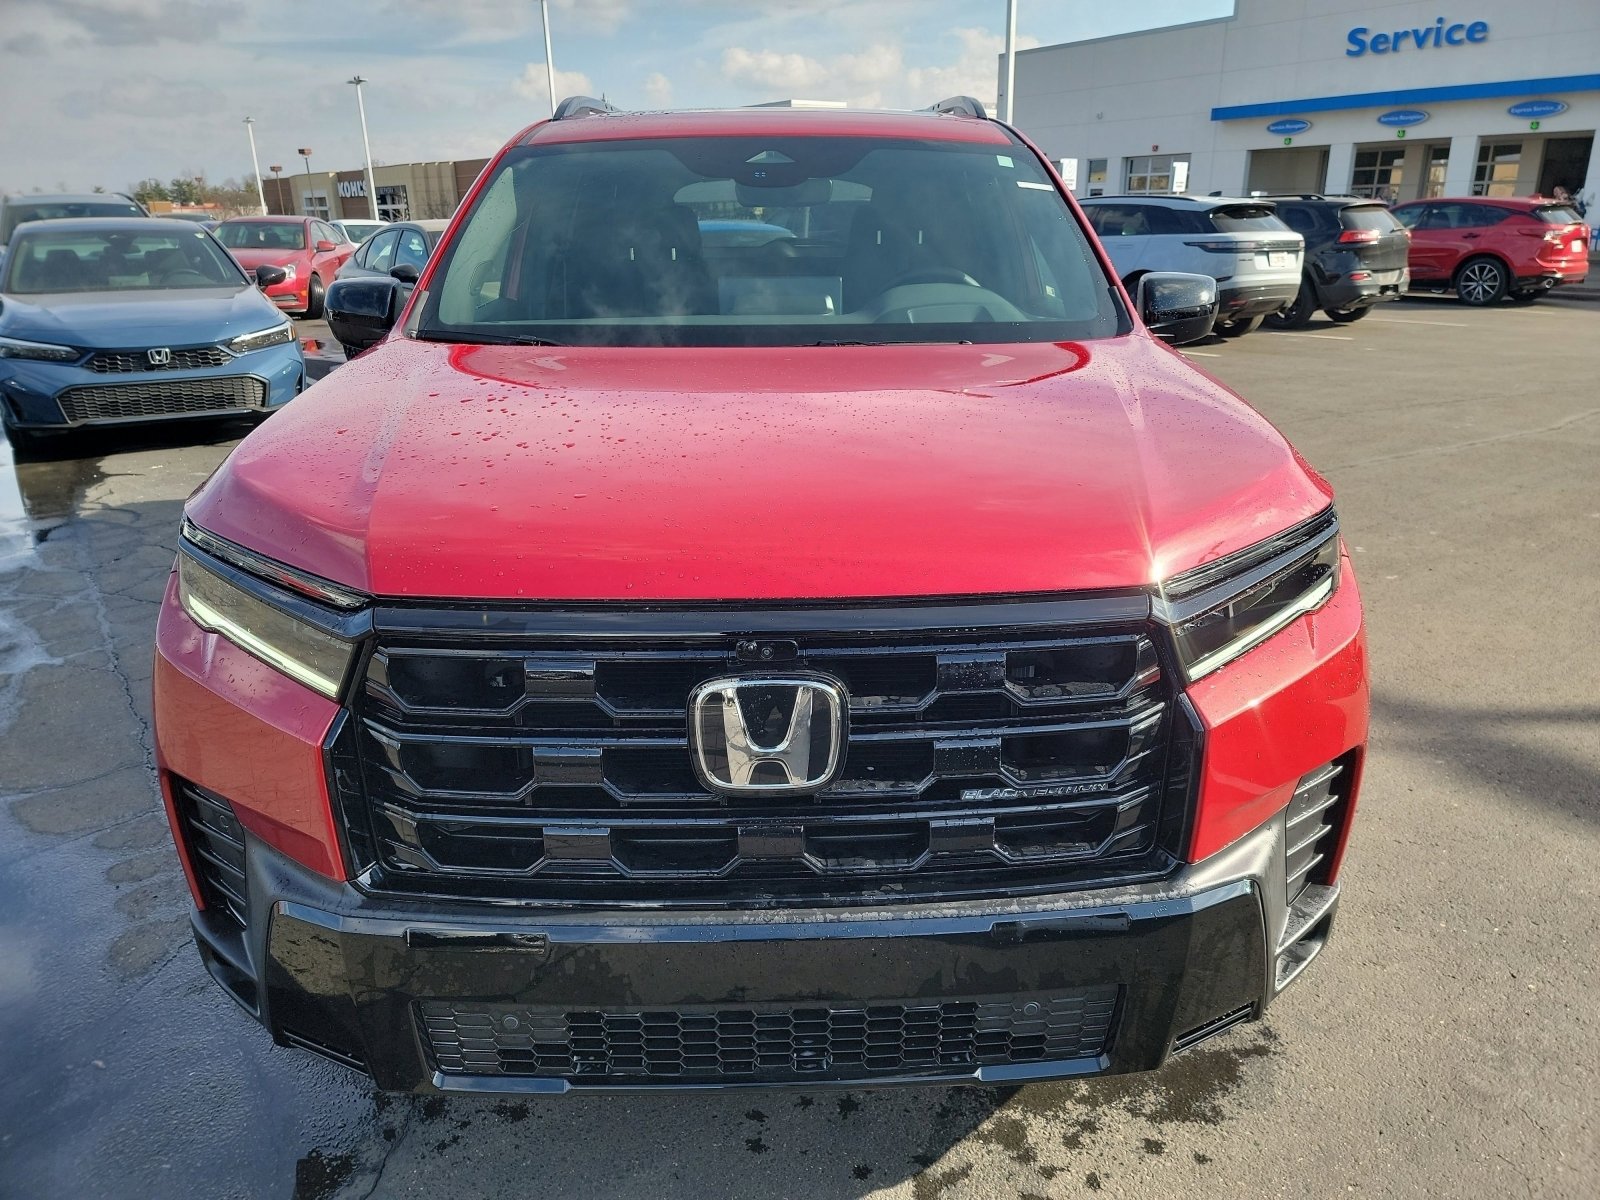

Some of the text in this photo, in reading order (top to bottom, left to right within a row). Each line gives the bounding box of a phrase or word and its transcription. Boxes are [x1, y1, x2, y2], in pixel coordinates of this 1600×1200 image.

[1345, 16, 1489, 57] Service
[337, 180, 368, 198] KOHL'S
[961, 788, 1028, 800] BLACK
